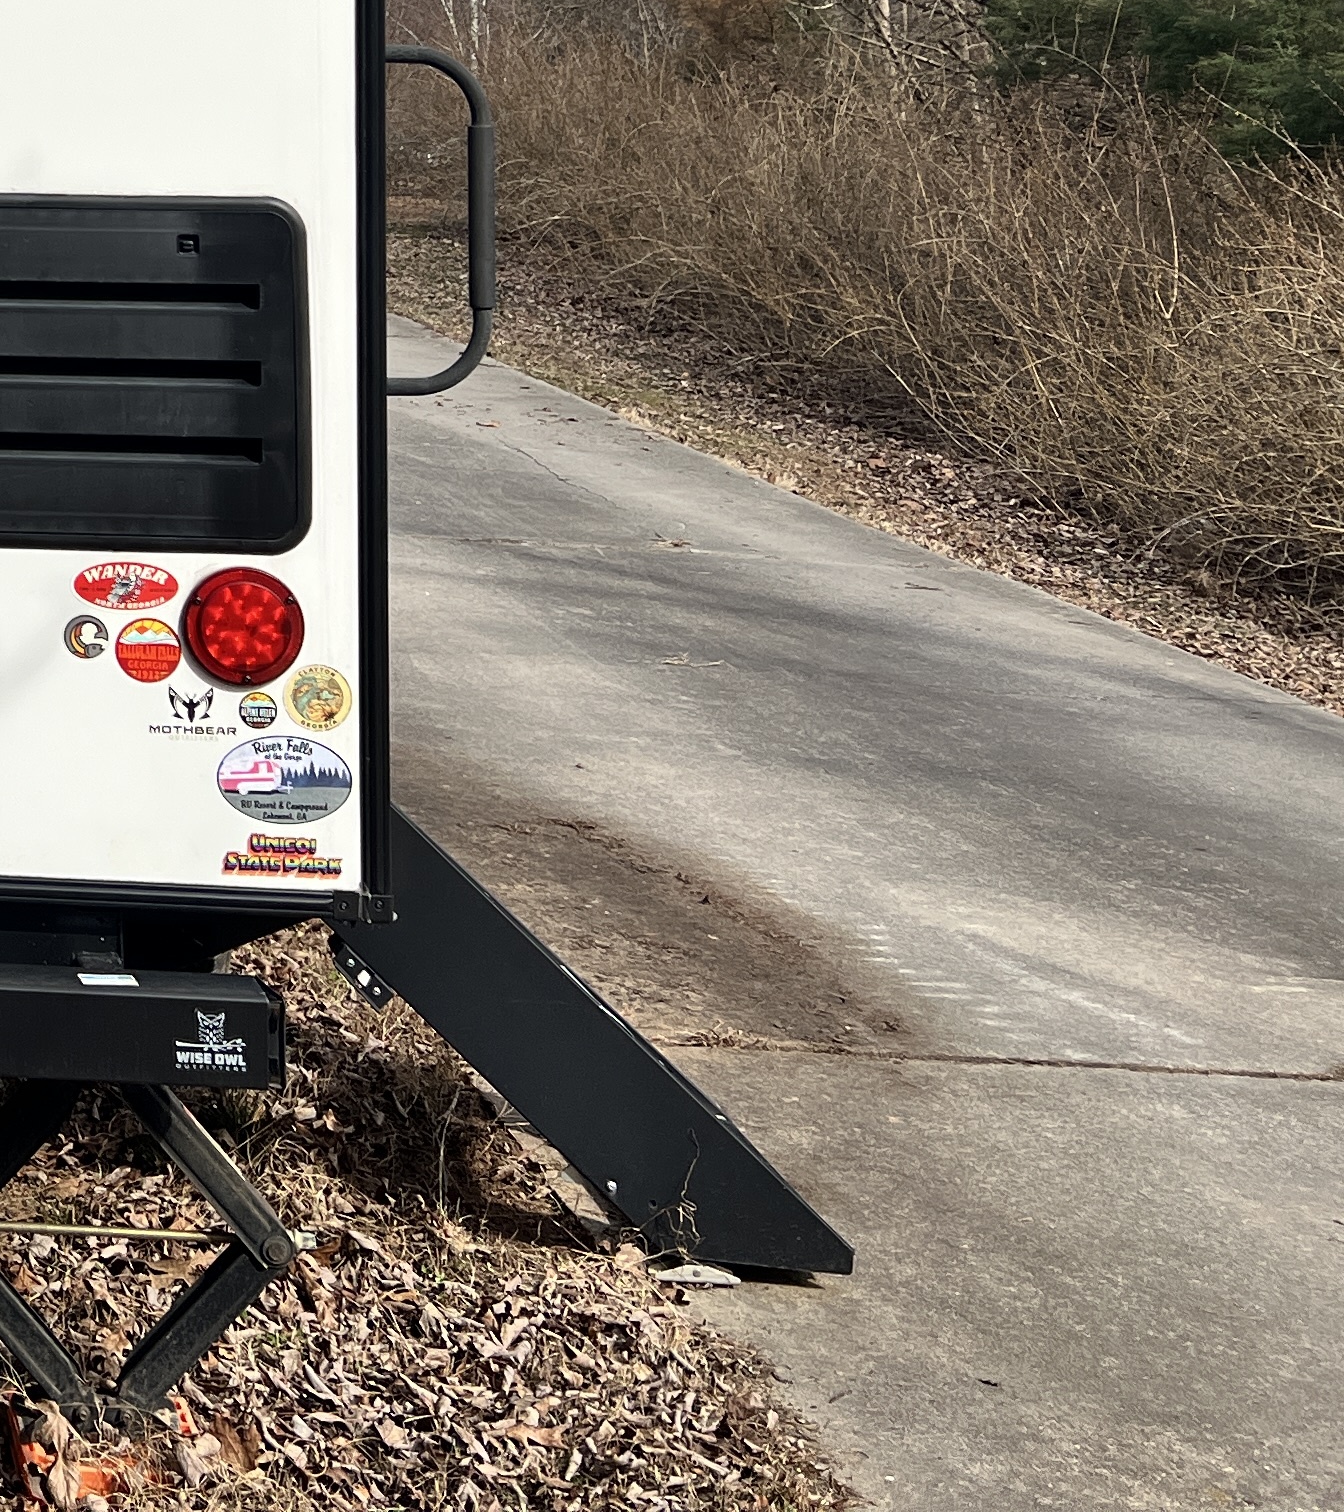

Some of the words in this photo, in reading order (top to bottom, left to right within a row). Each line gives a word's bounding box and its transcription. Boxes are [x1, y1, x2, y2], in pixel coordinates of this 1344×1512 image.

[83, 563, 169, 585] WANDER
[127, 660, 169, 670] GEORGIA
[298, 667, 337, 678] CLAYTON
[149, 725, 237, 736] MOTHBEAR
[300, 719, 338, 730] GEORGIA
[252, 741, 283, 754] River
[287, 739, 313, 755] Falls
[223, 851, 282, 873] STATE
[283, 854, 343, 876] PARK
[176, 1051, 212, 1064] WISE
[214, 1053, 247, 1066] OWL
